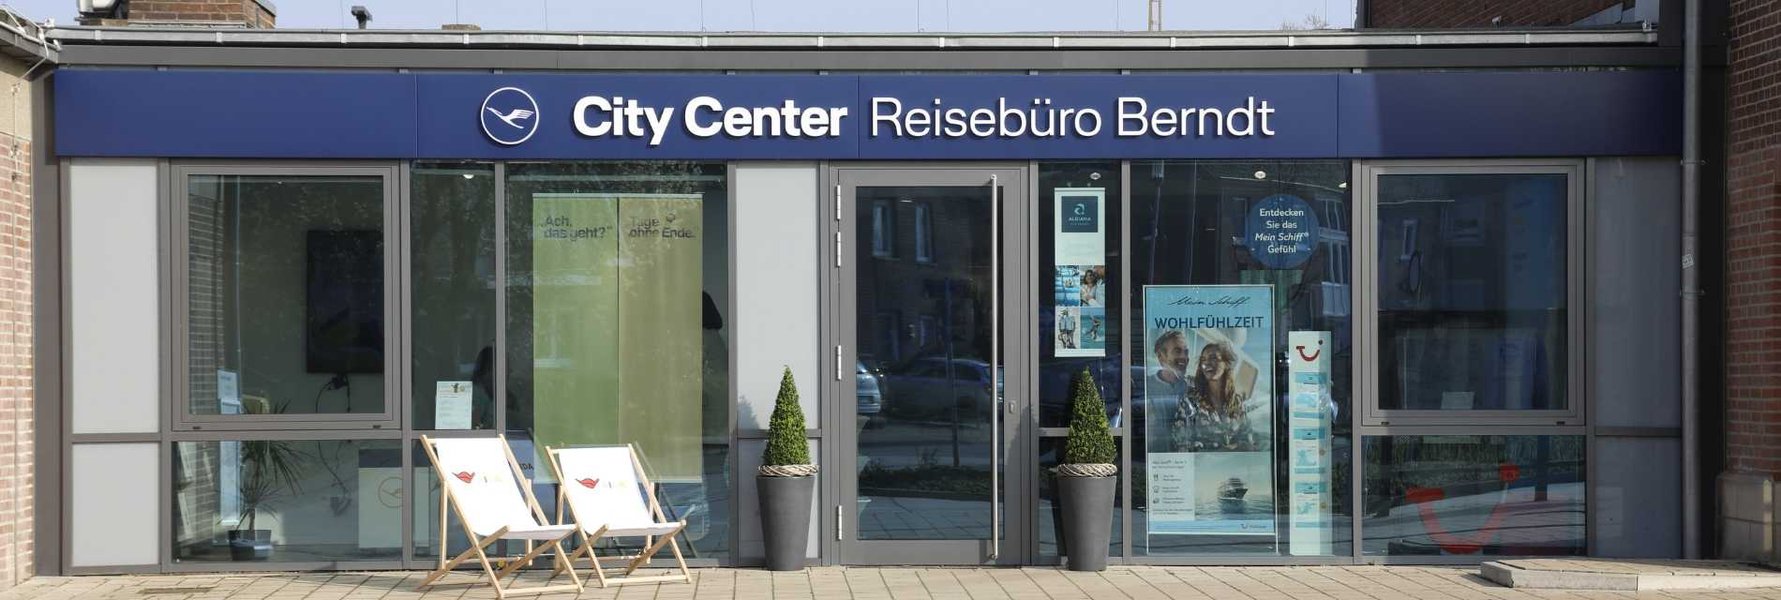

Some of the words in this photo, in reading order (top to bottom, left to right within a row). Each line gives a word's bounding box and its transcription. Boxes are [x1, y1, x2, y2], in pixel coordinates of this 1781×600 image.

[573, 96, 674, 145] City
[684, 96, 848, 137] Center
[871, 96, 1102, 137] Reisebüro
[1117, 96, 1275, 137] Berndt
[1259, 208, 1304, 217] Entdecken
[1266, 220, 1281, 229] Sie
[1282, 220, 1298, 229] das
[543, 227, 568, 239] das
[629, 227, 660, 239] ohne
[1254, 232, 1276, 241] Mein
[1267, 244, 1297, 254] Gefühl
[1154, 314, 1264, 329] WOHLFÜHLZEIT
